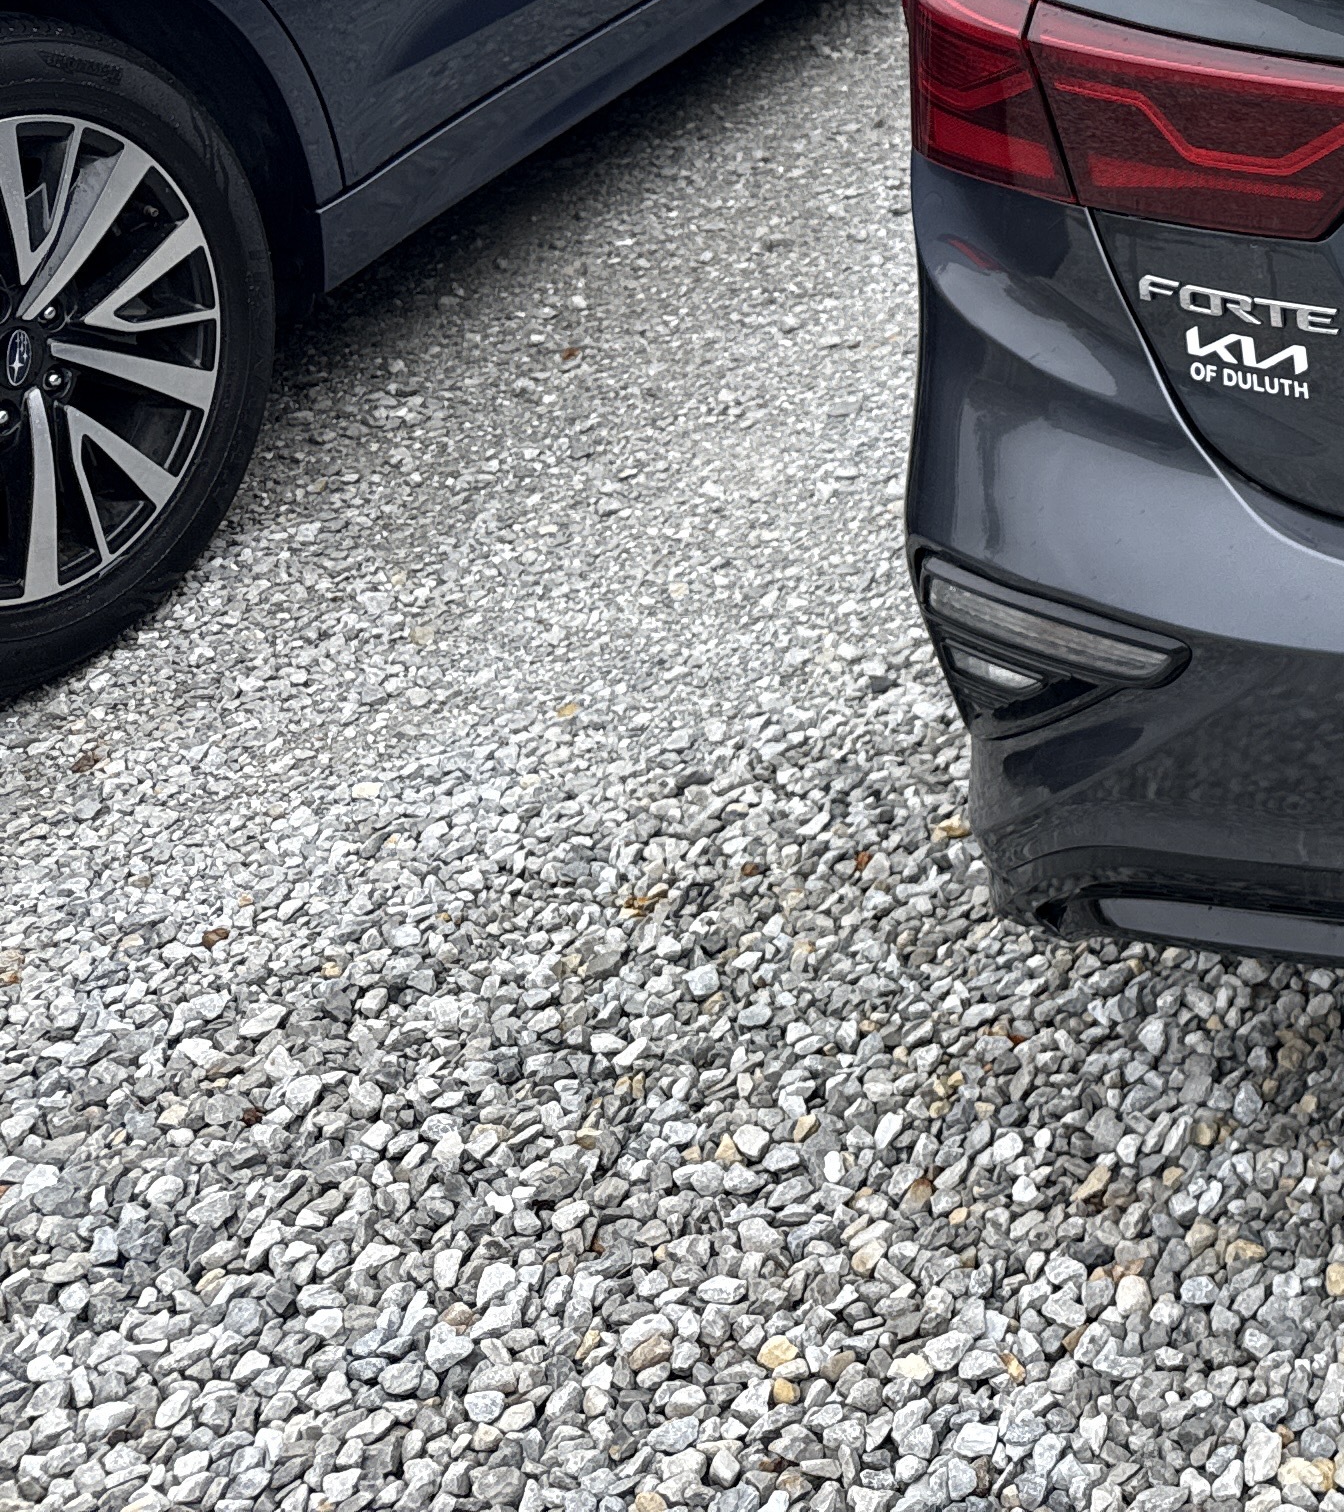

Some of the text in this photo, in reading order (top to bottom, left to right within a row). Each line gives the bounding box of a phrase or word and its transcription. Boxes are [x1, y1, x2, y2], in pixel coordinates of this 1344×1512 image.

[1138, 274, 1341, 336] FORTE
[1190, 362, 1310, 400] OF DULUTH
